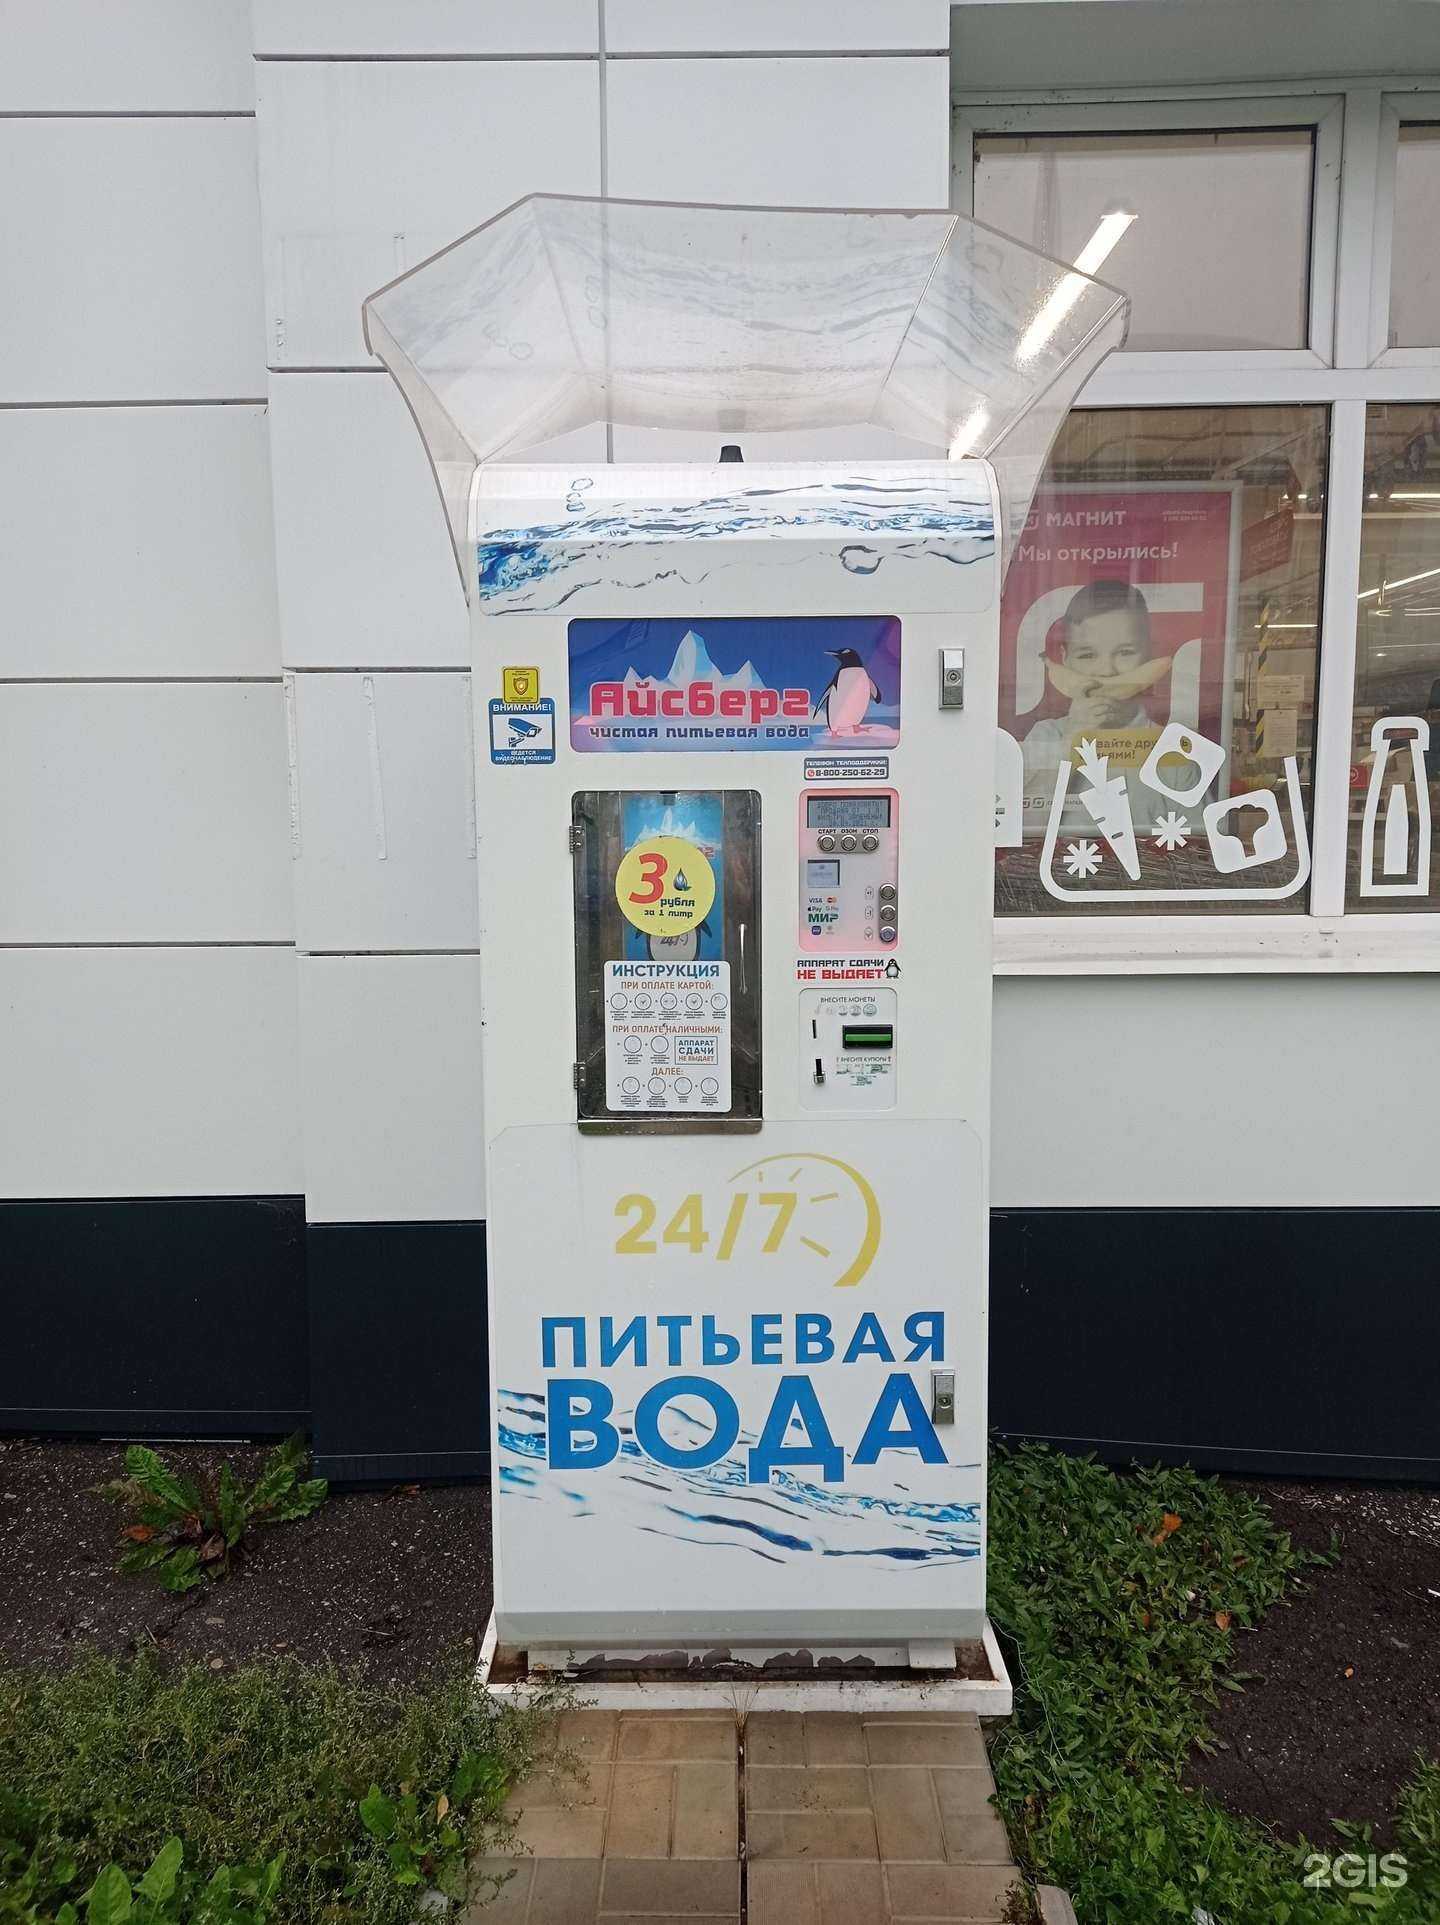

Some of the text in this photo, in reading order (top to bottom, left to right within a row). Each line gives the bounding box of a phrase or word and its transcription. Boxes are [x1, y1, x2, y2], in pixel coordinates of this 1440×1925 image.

[1046, 511, 1126, 527] МАГНИТ
[1019, 542, 1178, 564] Мы открылись!
[590, 682, 810, 723] Айсберг
[493, 704, 551, 712] ВНИМАНИЕ!
[590, 725, 809, 740] чистая питьевая вода
[628, 852, 668, 904] 3
[660, 897, 695, 907] рубля
[668, 910, 693, 918] литр
[808, 913, 838, 922] МИР
[849, 959, 884, 967] СДАЧИ
[612, 964, 720, 978] ИНСТРУКЦИЯ
[797, 969, 885, 979] НЕ ВЫДАЕТ
[621, 980, 714, 990] ПРИ ОПЛАТЕ КАРТОЙ:
[612, 1025, 629, 1033] ПРИ
[632, 1025, 663, 1034] ОПЛАТЕ
[678, 1047, 714, 1055] СДАЧИ
[651, 1067, 684, 1076] ДАЛЕЕ:
[614, 1193, 797, 1261] 24/7
[541, 1311, 945, 1368] ПИТЬЕВАЯ
[547, 1372, 949, 1485] ВОДА
